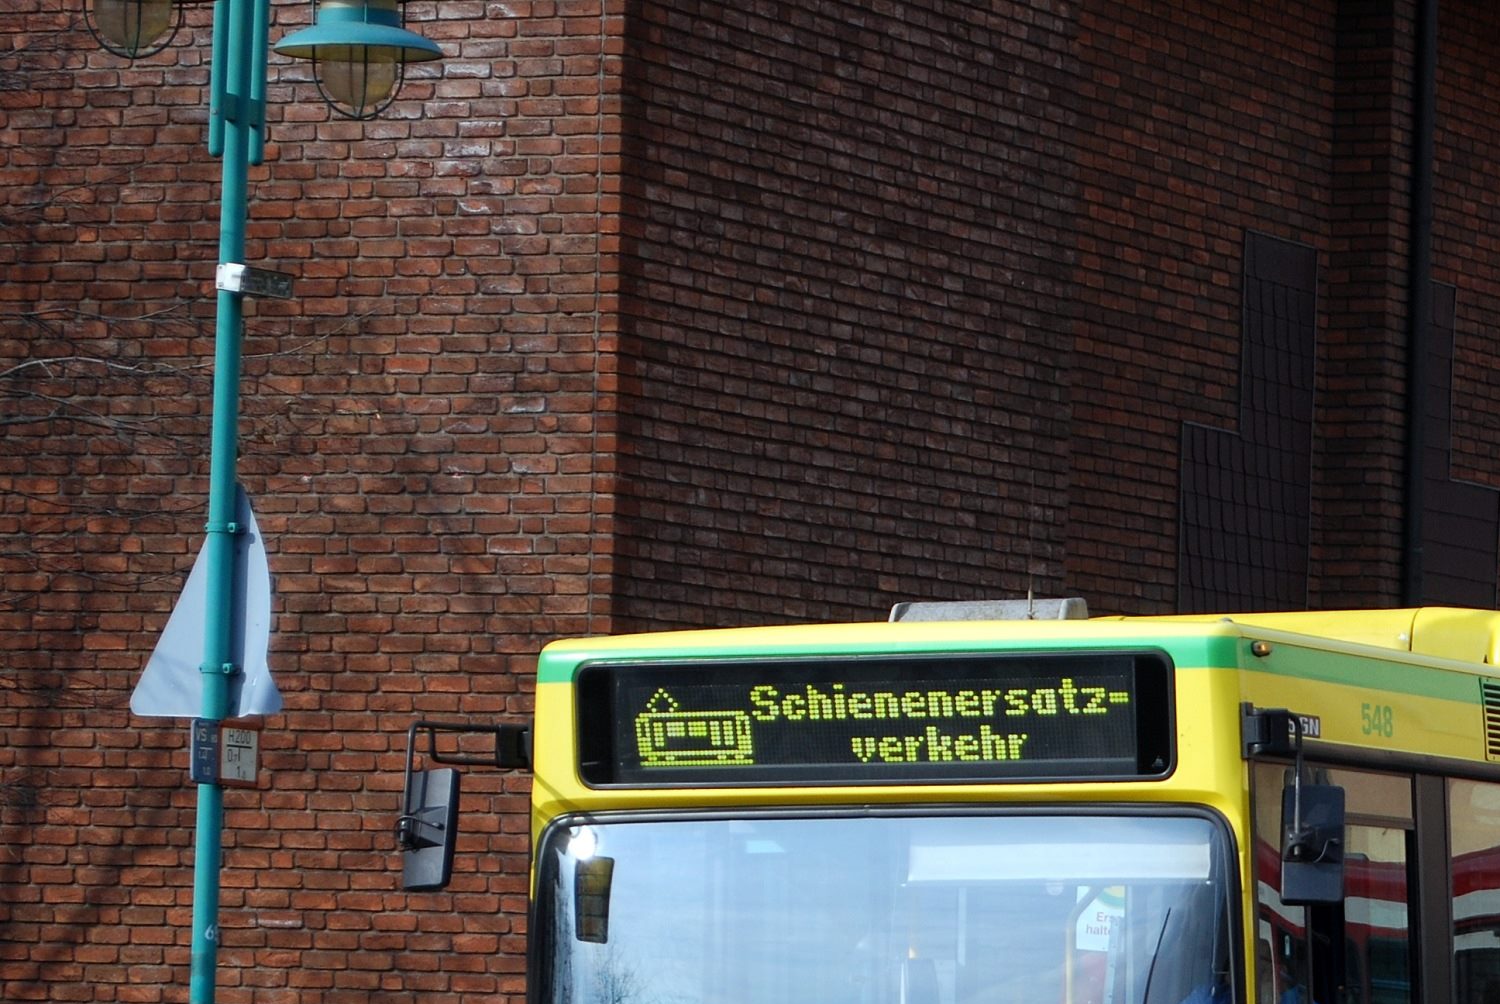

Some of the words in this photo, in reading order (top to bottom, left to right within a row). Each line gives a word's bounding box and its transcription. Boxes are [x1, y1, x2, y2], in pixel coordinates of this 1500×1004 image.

[750, 679, 1128, 722] Schienenersatz-
[1361, 700, 1393, 737] 548
[852, 726, 1031, 763] verkehr
